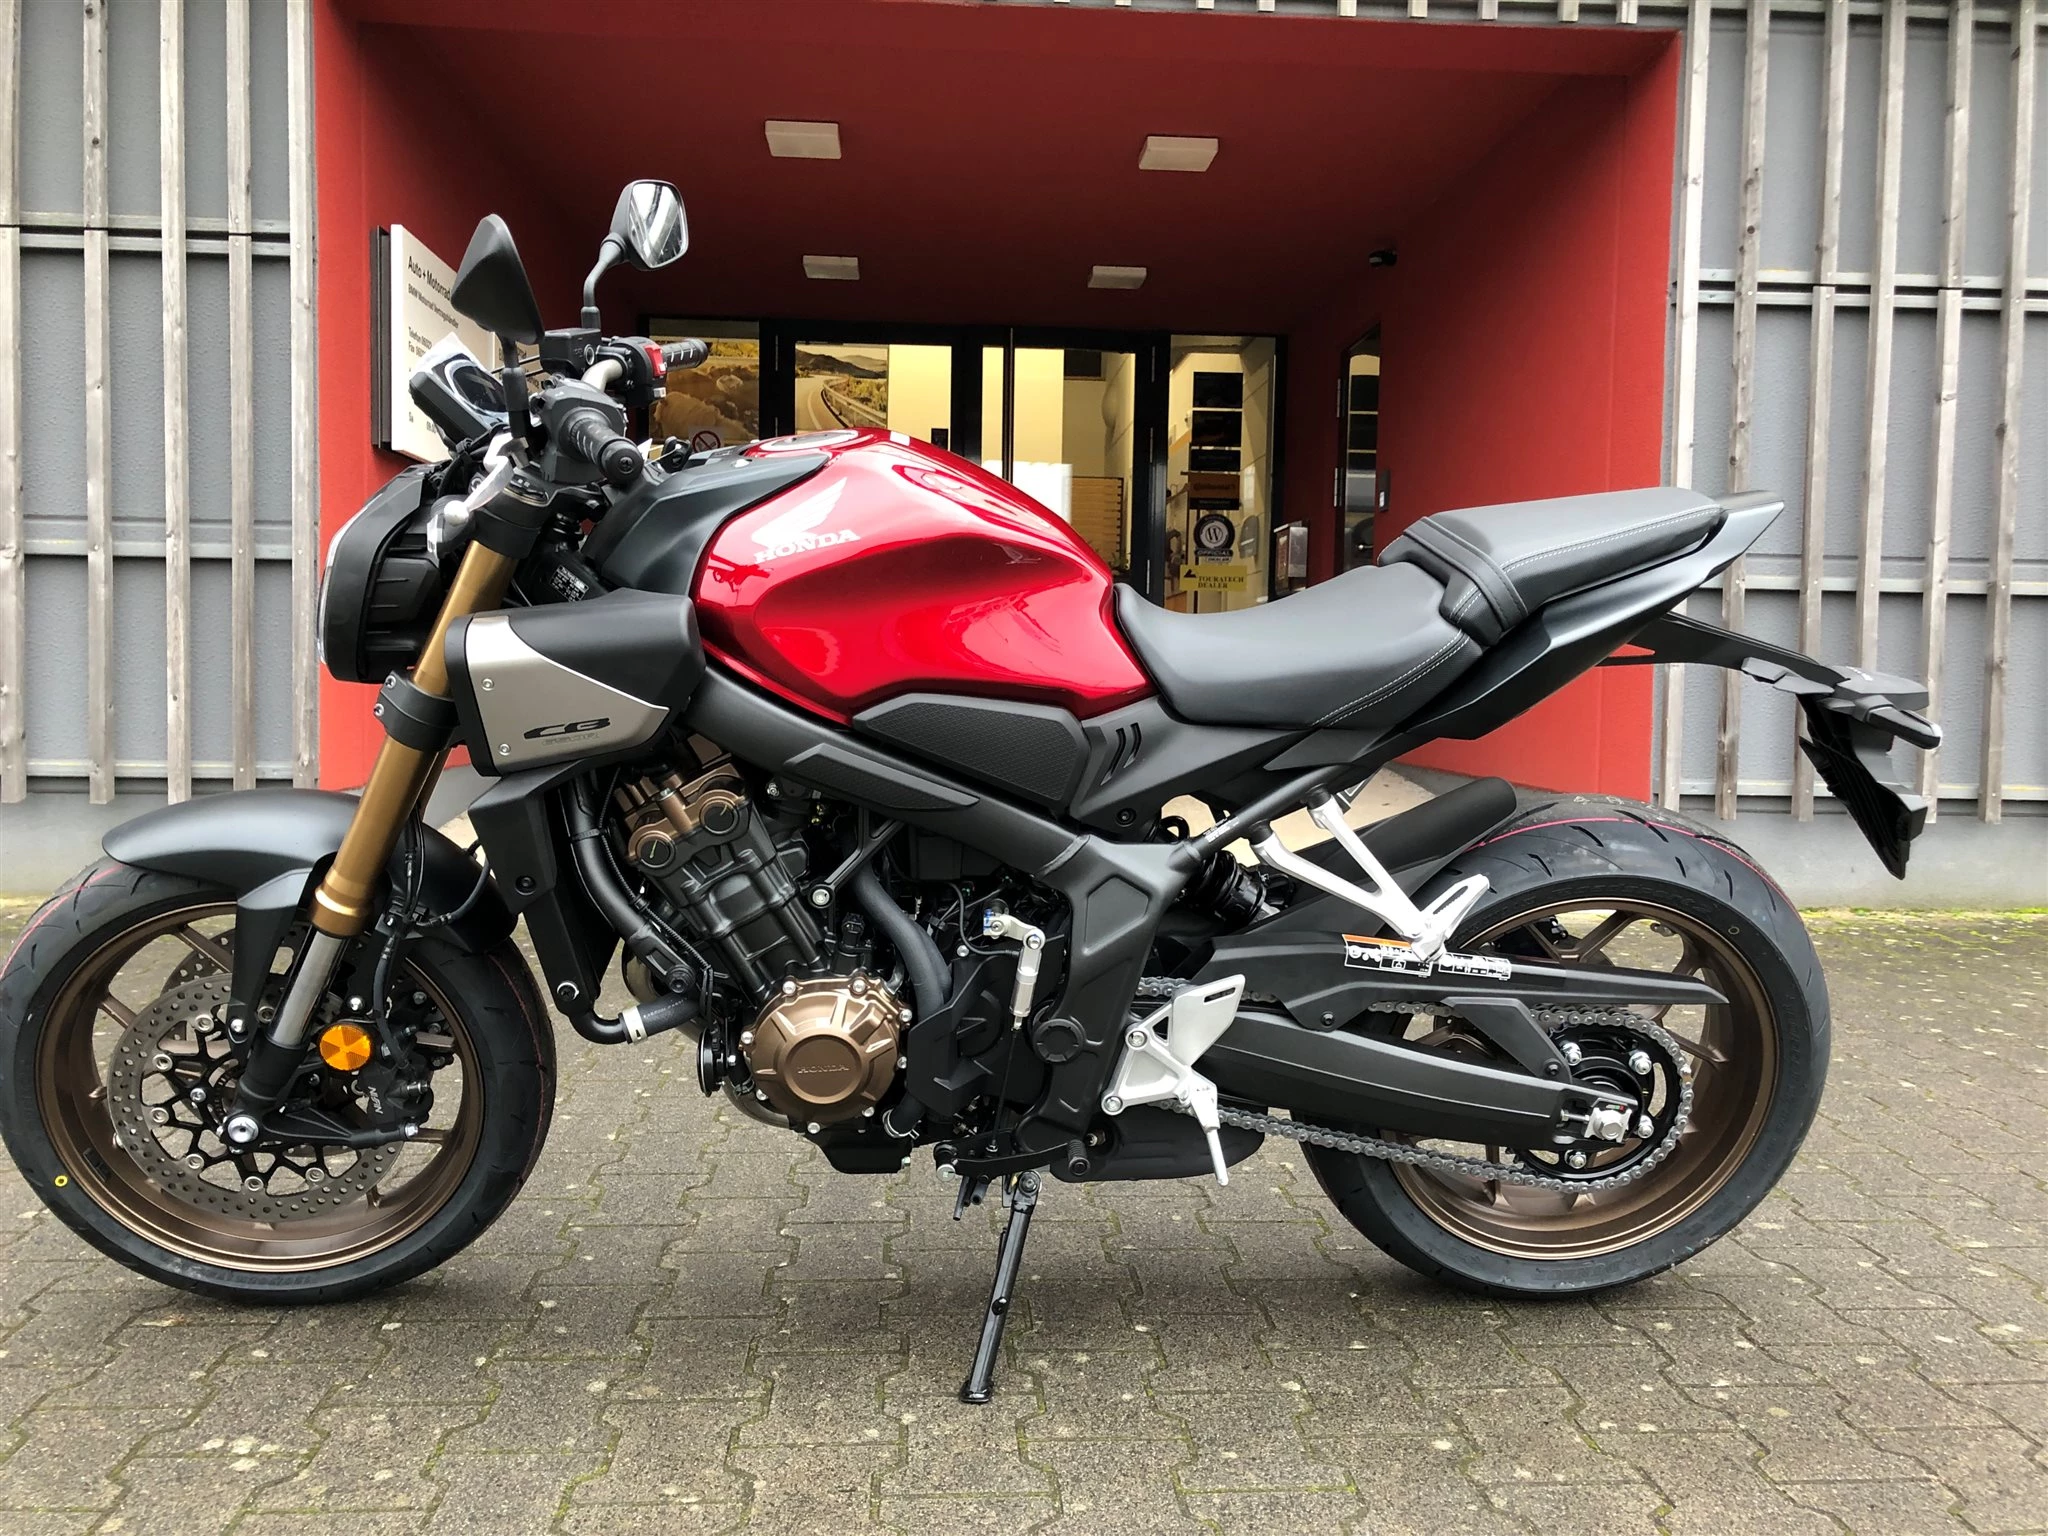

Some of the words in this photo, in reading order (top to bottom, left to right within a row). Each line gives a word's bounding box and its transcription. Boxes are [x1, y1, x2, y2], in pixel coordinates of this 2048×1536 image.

[408, 255, 421, 278] Auto
[427, 269, 451, 301] Motorrad
[754, 529, 861, 565] HONDA
[524, 717, 611, 739] CB
[797, 1064, 851, 1074] HONDA
